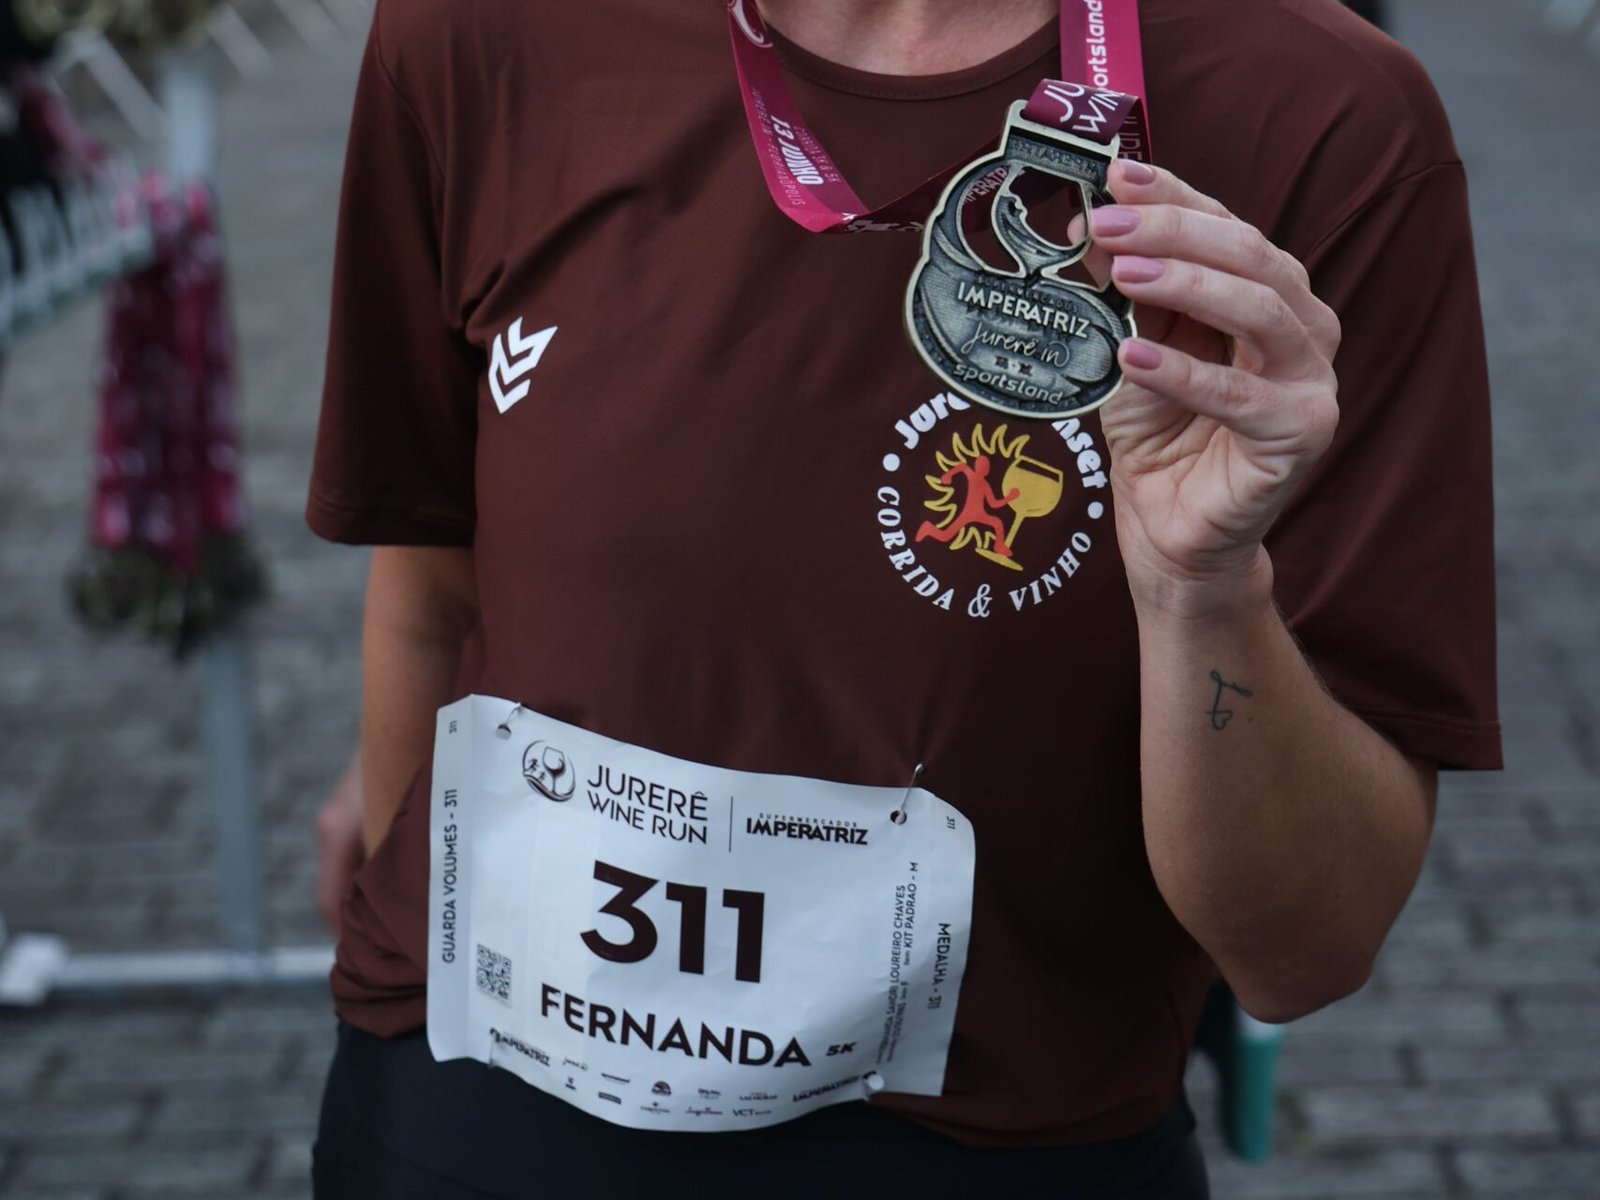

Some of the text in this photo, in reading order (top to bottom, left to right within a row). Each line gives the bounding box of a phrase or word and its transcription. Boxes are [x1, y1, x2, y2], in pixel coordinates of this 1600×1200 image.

[770, 115, 824, 185] 13 JUNHO
[957, 281, 1091, 339] IMPERATRIZ
[953, 363, 1064, 405] sportsland
[894, 391, 1108, 489] Jur nset
[877, 486, 1092, 618] CORRIDA & VINHO
[449, 720, 458, 735] 311
[444, 788, 458, 809] 311
[587, 765, 709, 821] JURERÊ
[587, 790, 708, 845] WINE RUN
[758, 812, 858, 827] SUPERMERCADOS
[746, 817, 869, 846] IMPERATRIZ
[444, 824, 458, 896] VOLUMES
[442, 899, 457, 964] GUARDA
[580, 859, 766, 984] 311
[893, 885, 906, 929] CHAVES
[903, 931, 914, 949] KIT
[909, 861, 919, 872] M
[889, 931, 903, 983] LOUREIRO
[930, 922, 952, 986] MEDALHA
[541, 982, 812, 1068] FERNANDA
[926, 995, 942, 1009] 311
[825, 1041, 858, 1056] 5K
